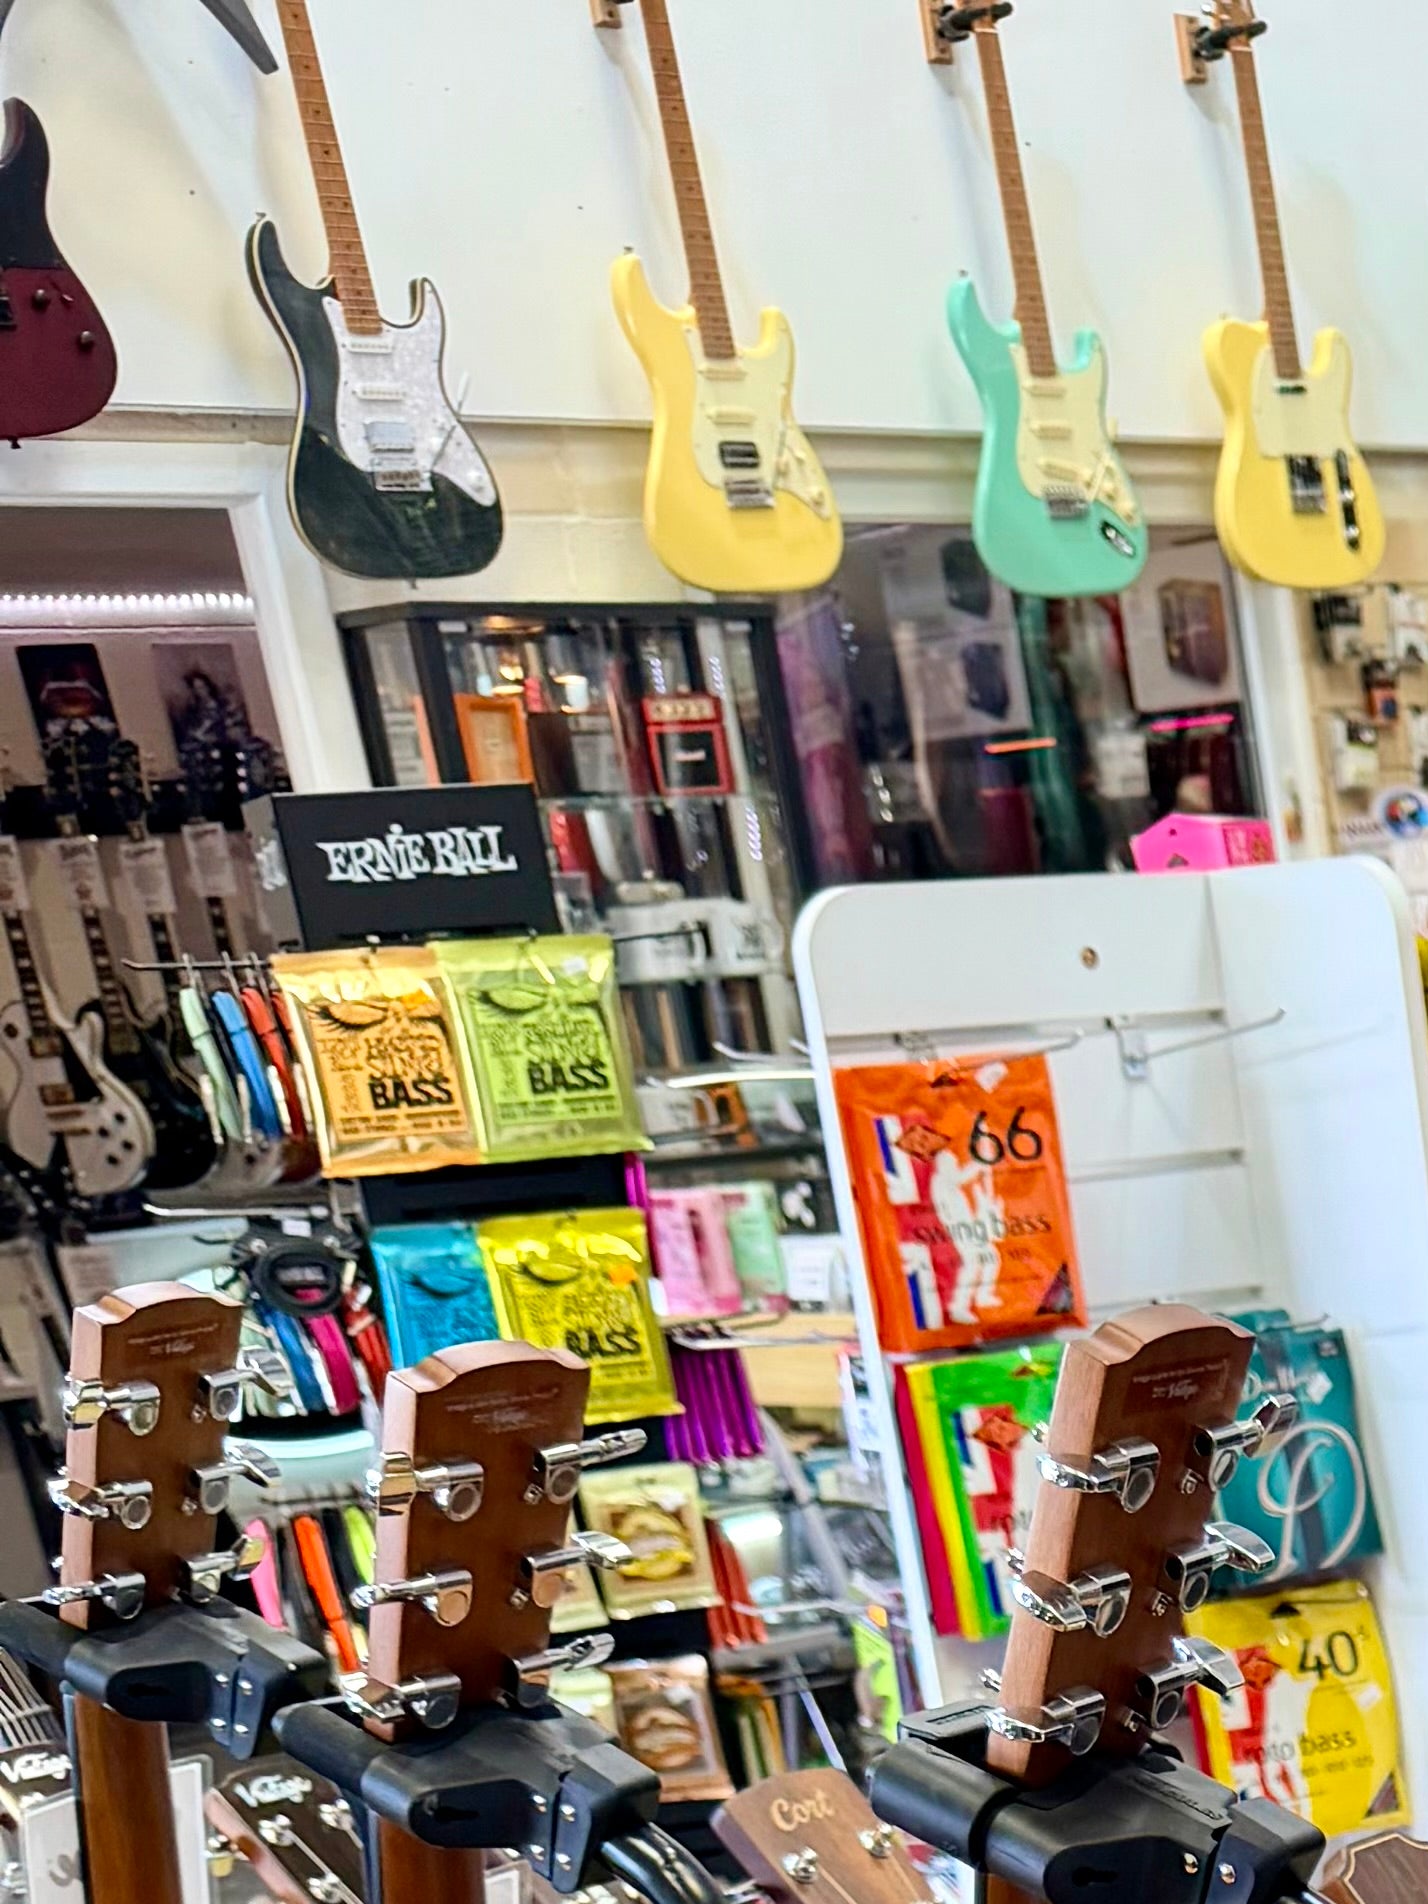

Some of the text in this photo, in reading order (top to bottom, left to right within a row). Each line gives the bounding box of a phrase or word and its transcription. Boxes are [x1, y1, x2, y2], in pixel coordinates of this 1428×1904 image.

[315, 824, 431, 882] ERNIE
[426, 826, 518, 875] BALL
[369, 1077, 455, 1111] BASS
[527, 1060, 610, 1094] BASS
[969, 1106, 1043, 1165] 66
[991, 1211, 1053, 1237] bass
[1298, 1630, 1360, 1681] 40
[1300, 1731, 1357, 1756] bass
[769, 1790, 834, 1832] Cort
